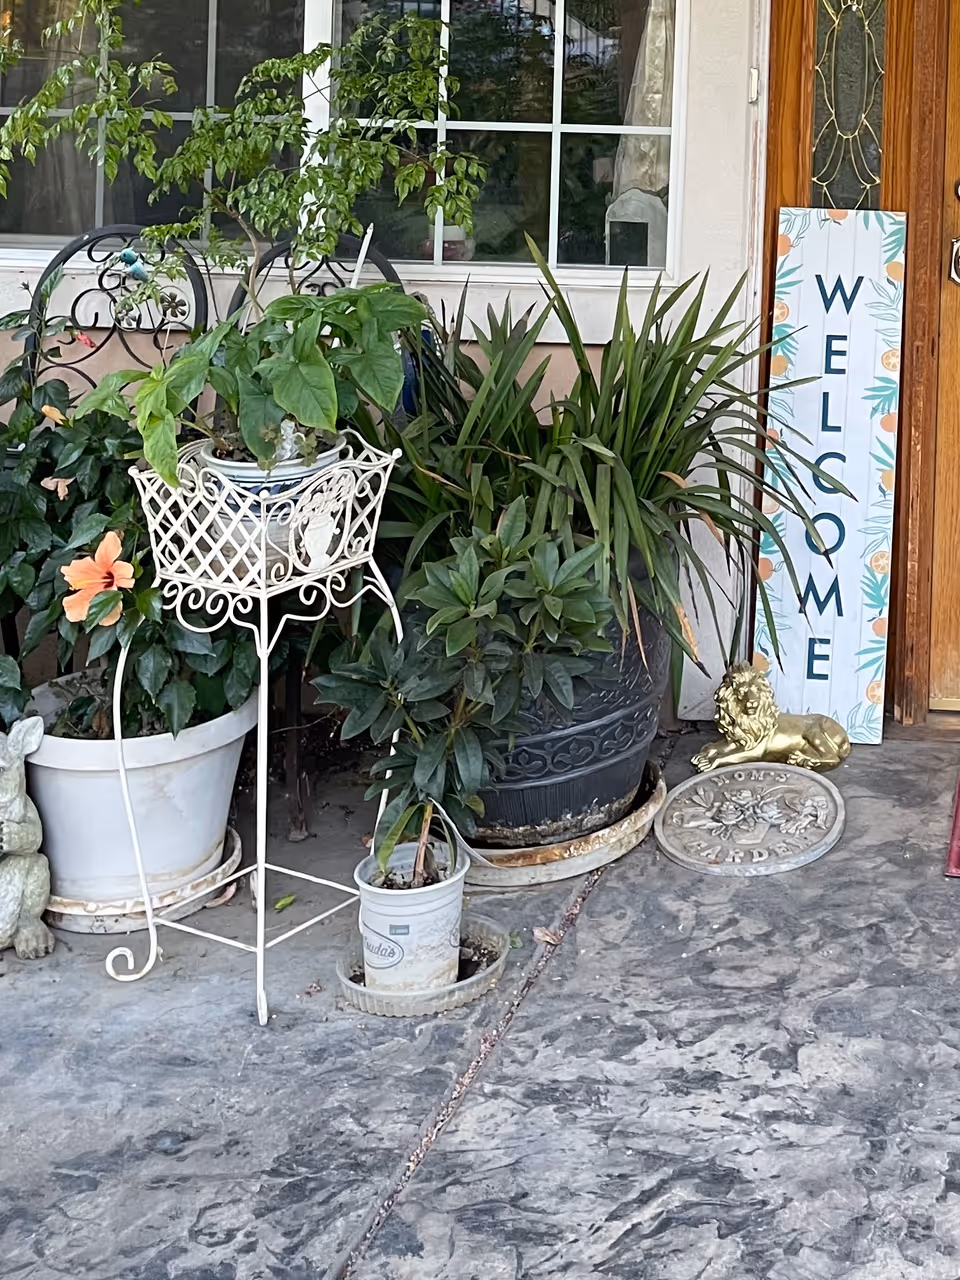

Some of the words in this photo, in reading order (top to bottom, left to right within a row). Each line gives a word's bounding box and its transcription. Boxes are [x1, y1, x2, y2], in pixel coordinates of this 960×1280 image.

[797, 273, 865, 682] WELCOME
[710, 770, 791, 788] MOM'S
[686, 834, 813, 864] GARDEN
